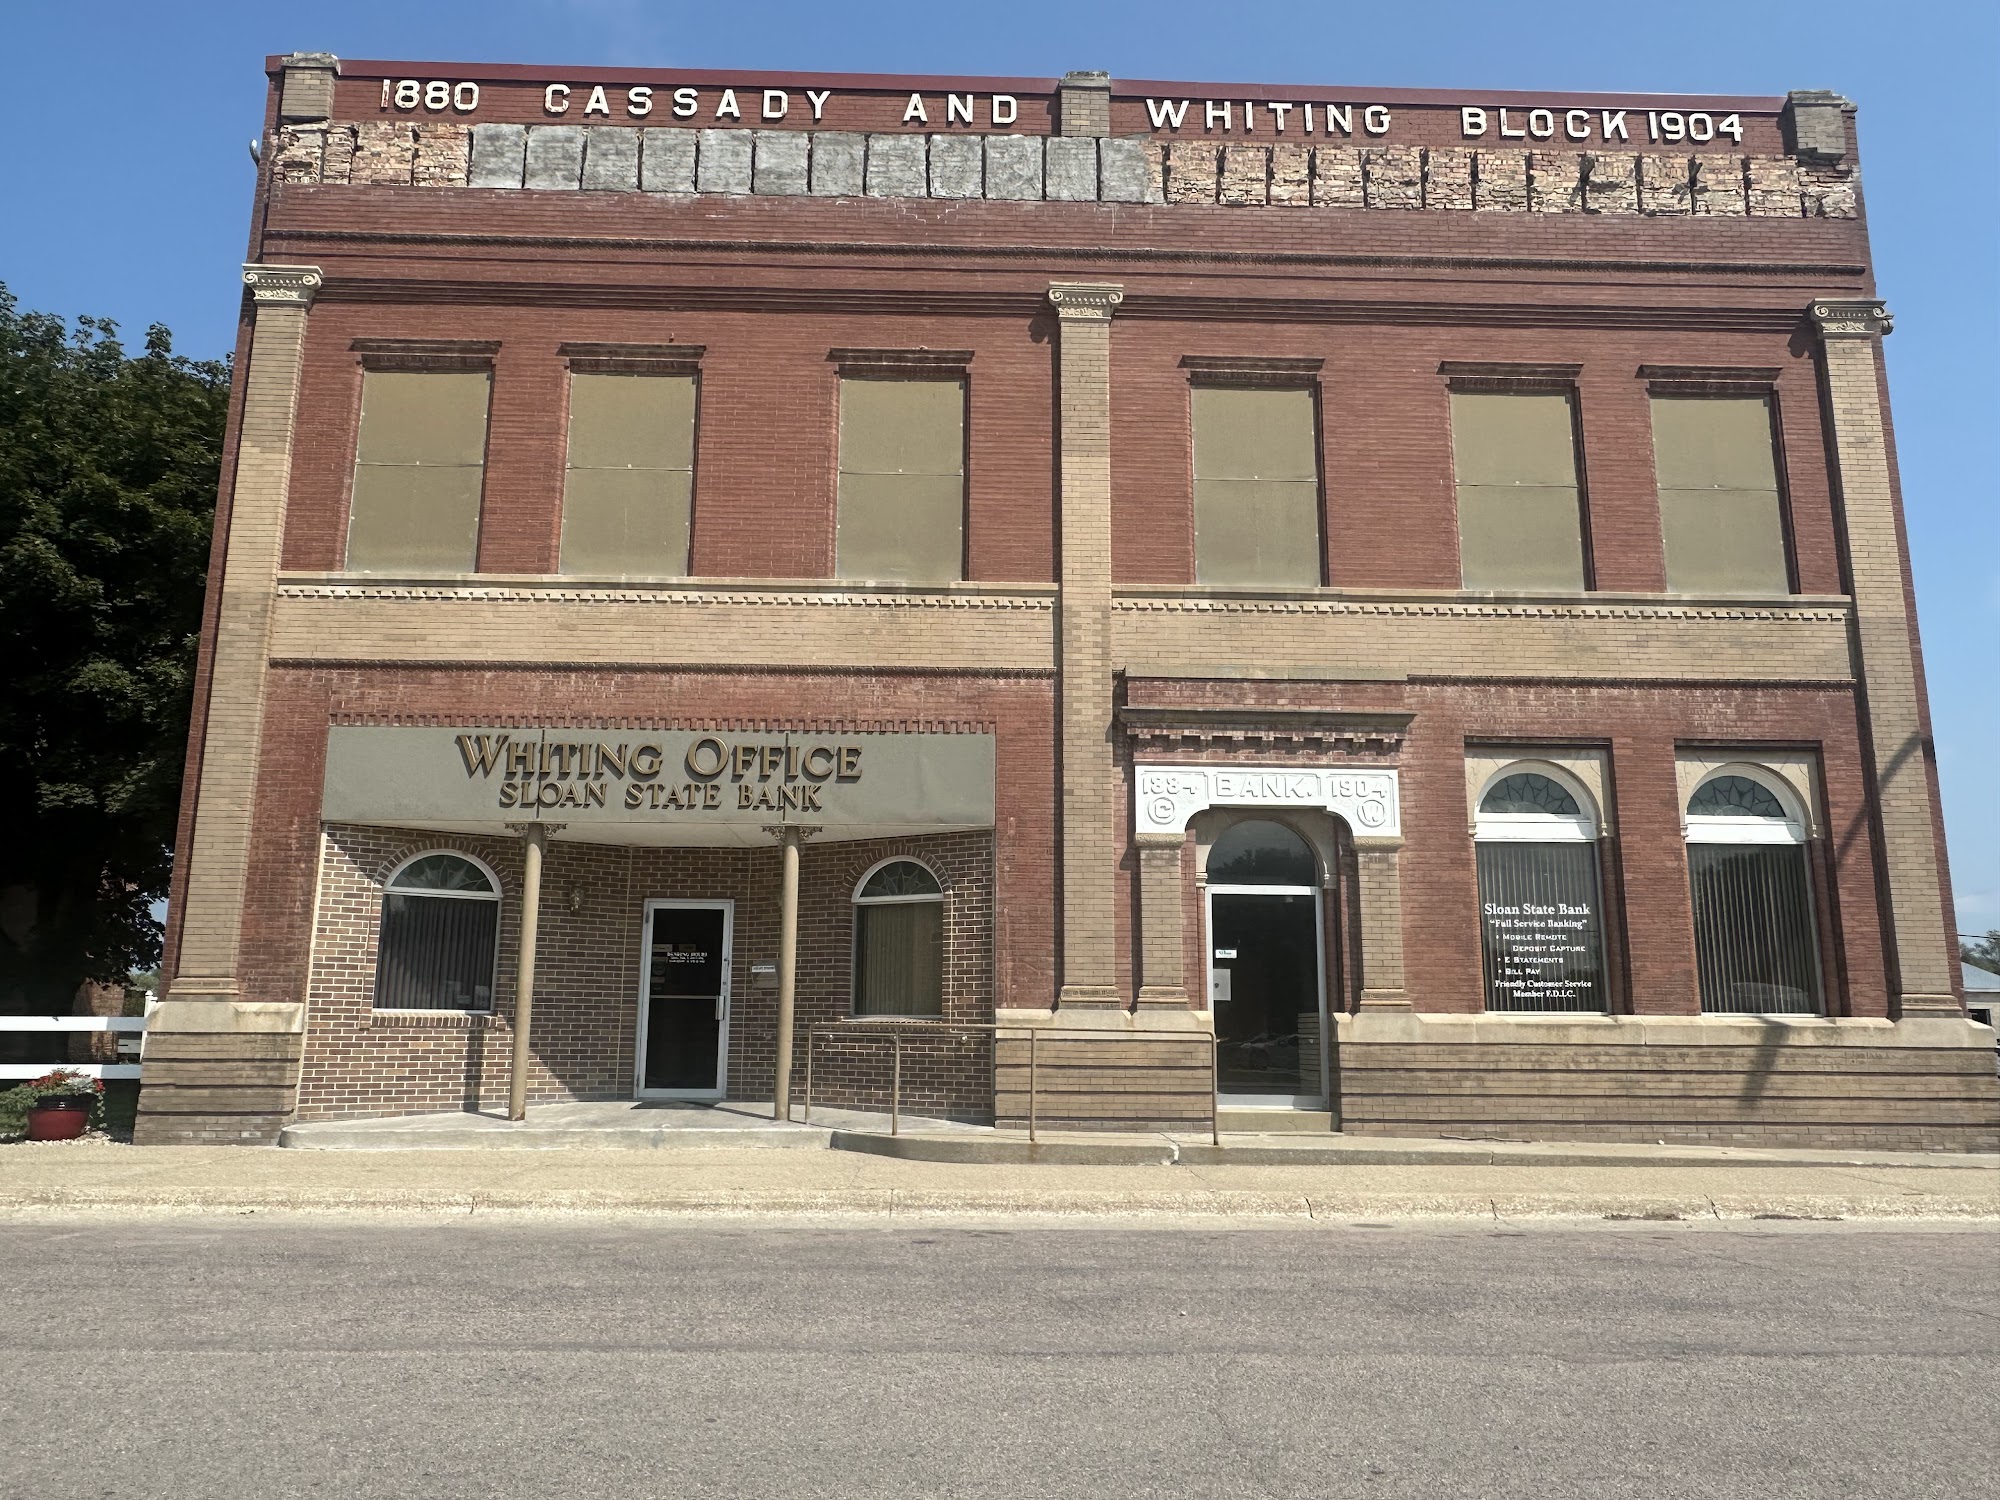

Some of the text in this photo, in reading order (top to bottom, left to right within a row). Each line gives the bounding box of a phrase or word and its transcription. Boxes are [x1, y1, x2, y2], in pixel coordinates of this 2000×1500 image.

[382, 79, 1019, 123] 1880 CASSADY AND
[1146, 98, 1743, 143] WHITING BLOCK 1904
[1142, 776, 1200, 795] 1884
[1331, 780, 1388, 798] 1904
[499, 781, 824, 812] SLOAN STATE BANK
[1484, 903, 1591, 915] Sloan State Bank
[1513, 920, 1546, 928] Service
[1495, 980, 1592, 989] Friendly Customer Service
[1513, 990, 1544, 998] Member
